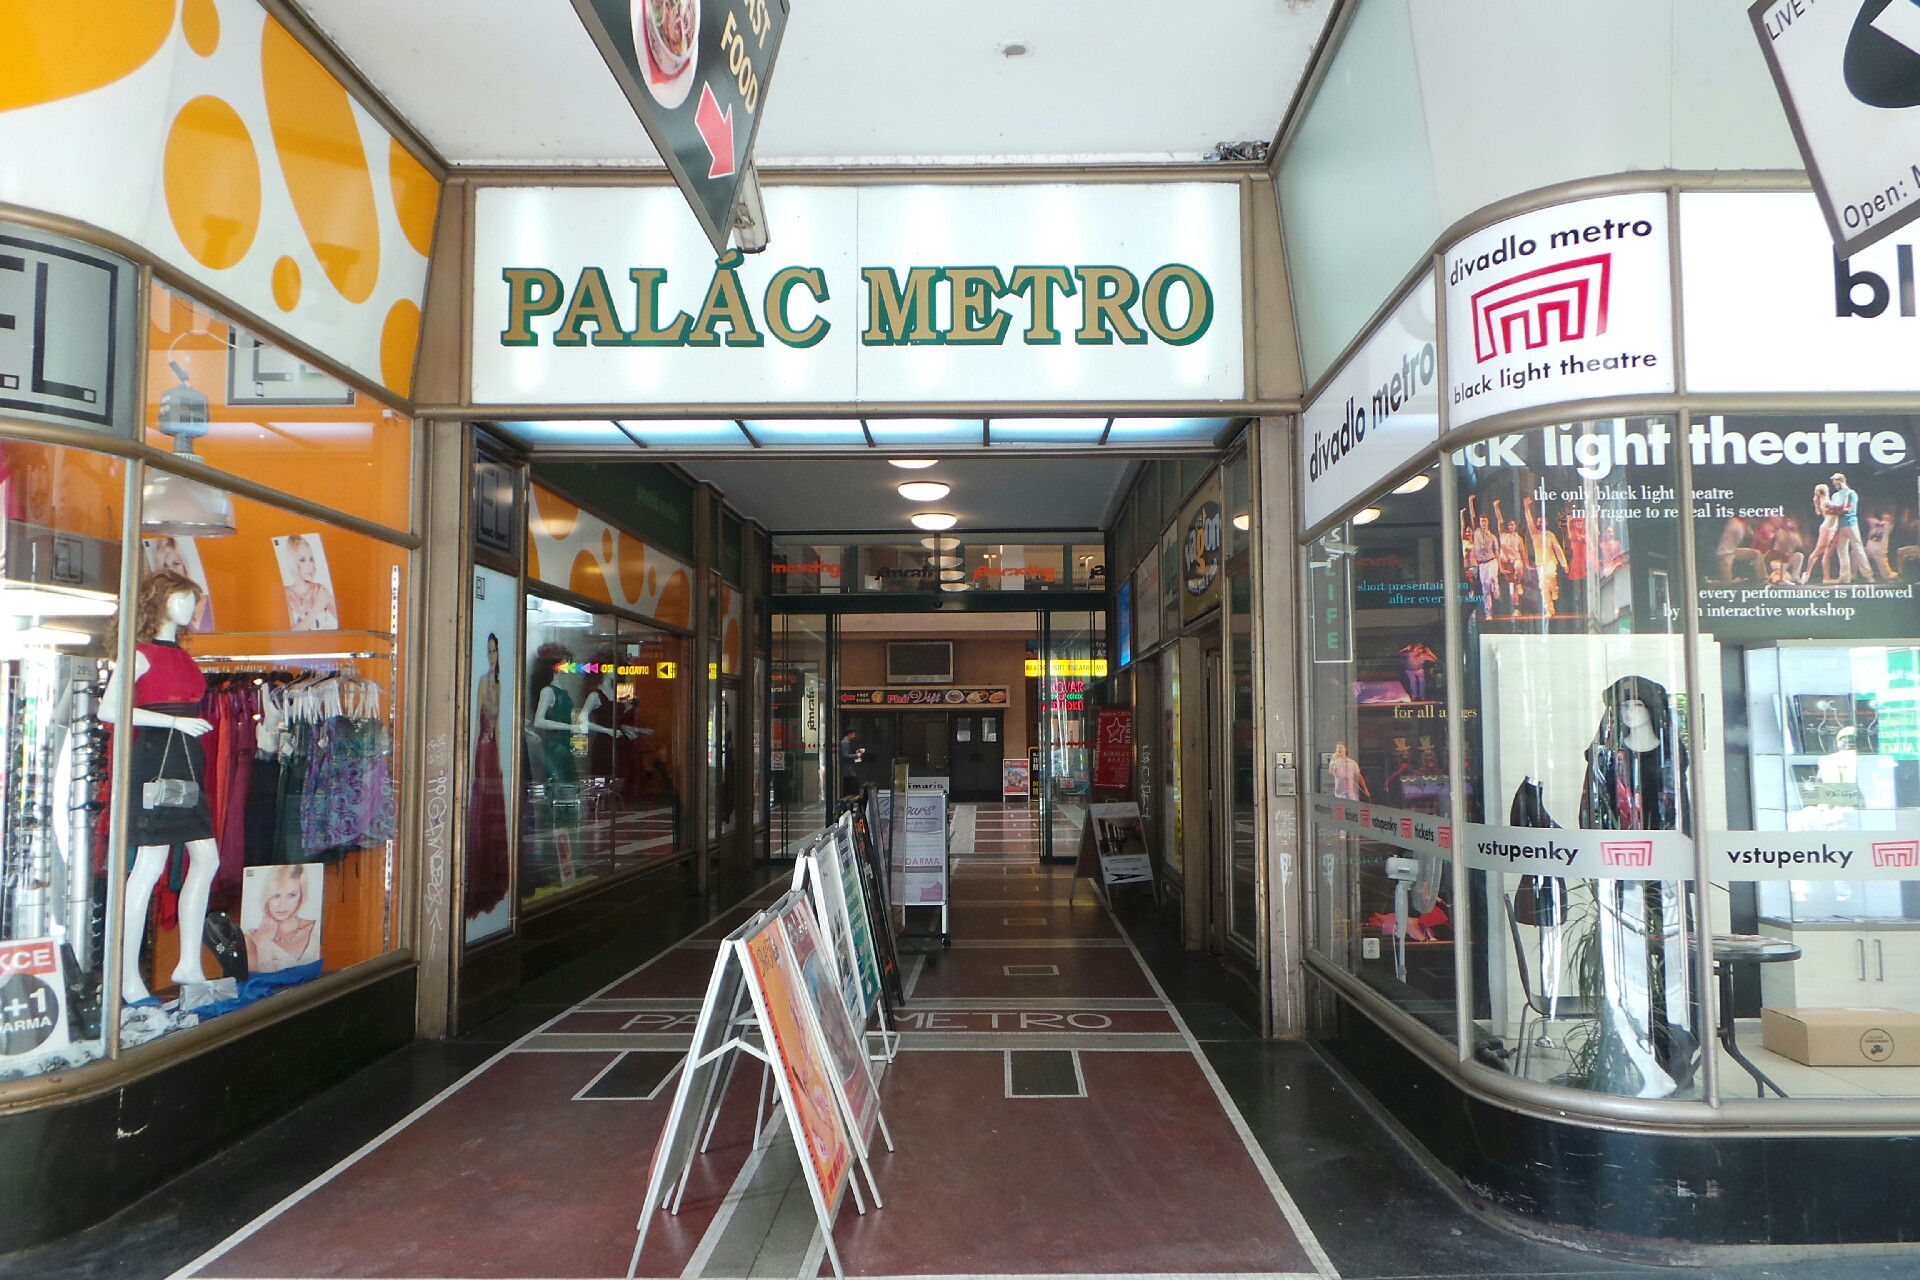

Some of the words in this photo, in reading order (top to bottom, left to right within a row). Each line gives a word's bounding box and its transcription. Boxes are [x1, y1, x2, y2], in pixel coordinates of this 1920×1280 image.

[1766, 0, 1806, 41] LIVE
[721, 10, 758, 114] FOOD
[1843, 181, 1908, 229] Open:
[1450, 234, 1537, 287] divadlo
[1550, 218, 1653, 250] metro
[500, 247, 832, 349] PALÁC
[860, 262, 1215, 347] METRO
[1454, 375, 1494, 405] black
[1500, 362, 1551, 390] light
[1559, 351, 1658, 377] theatre
[1309, 396, 1366, 483] divadlo
[1372, 342, 1435, 430] metro
[1543, 418, 1671, 480] light
[1689, 415, 1907, 465] theatre
[1534, 485, 1557, 501] the
[1561, 485, 1591, 503] only
[1595, 484, 1637, 501] black
[1640, 484, 1675, 504] light
[1572, 505, 1586, 519] in
[1590, 504, 1642, 525] Prague
[1646, 505, 1660, 519] to
[1715, 503, 1734, 518] its
[1738, 504, 1785, 518] secret
[1357, 580, 1385, 592] short
[1389, 593, 1415, 604] after
[1699, 589, 1737, 603] every
[1741, 585, 1830, 603] performance
[1834, 585, 1847, 599] is
[1851, 584, 1913, 599] followed
[1663, 603, 1680, 620] by
[1707, 603, 1782, 617] interactive
[1785, 602, 1855, 620] workshop
[1393, 705, 1413, 719] for
[1417, 704, 1434, 718] all
[1414, 824, 1434, 842] tickets
[1477, 840, 1579, 866] vstupenky
[1726, 843, 1854, 869] vstupenky
